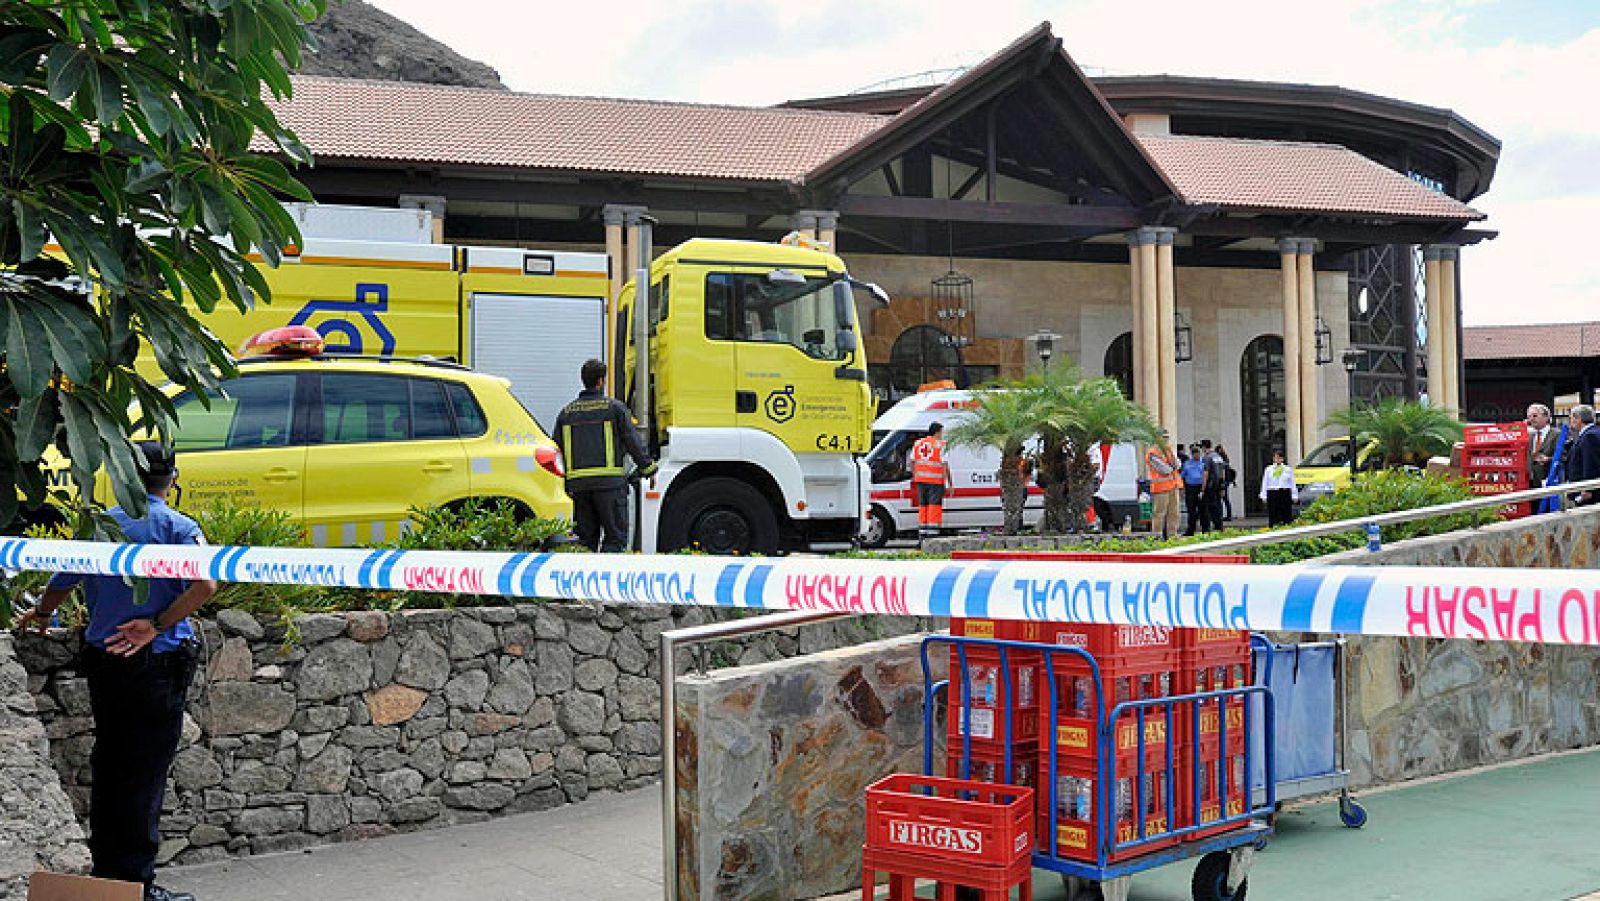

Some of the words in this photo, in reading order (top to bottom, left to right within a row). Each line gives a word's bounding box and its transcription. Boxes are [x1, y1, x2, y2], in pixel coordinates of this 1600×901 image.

[816, 434, 851, 451] C4.1
[550, 570, 612, 601] LOCAL
[617, 572, 697, 603] POLICIA
[785, 574, 867, 613] PASAR
[871, 575, 909, 615] NO
[1014, 579, 1113, 624] LOCAL
[1122, 581, 1250, 630] POLICIA
[1405, 585, 1544, 643] PASAR
[1120, 625, 1169, 646] FIRGAS
[891, 821, 982, 852] FIRGAS
